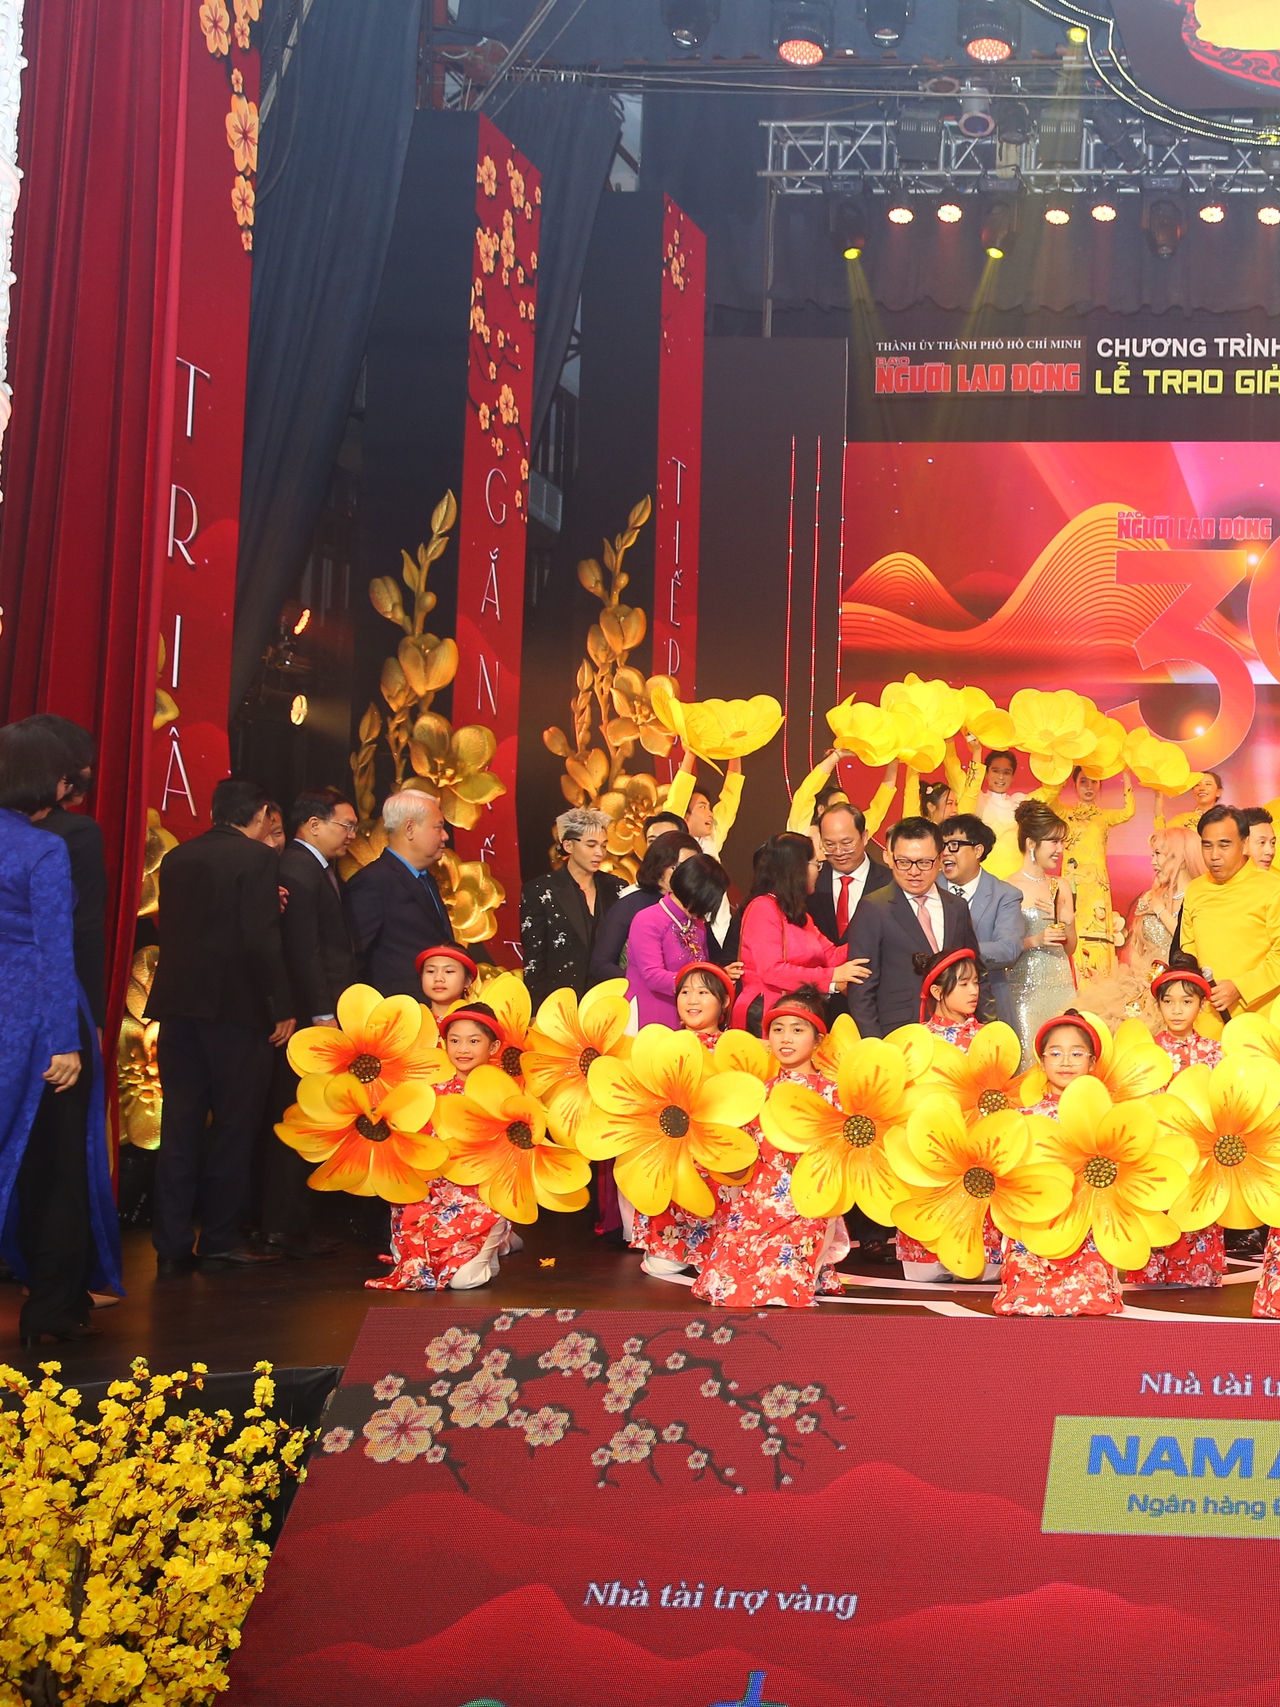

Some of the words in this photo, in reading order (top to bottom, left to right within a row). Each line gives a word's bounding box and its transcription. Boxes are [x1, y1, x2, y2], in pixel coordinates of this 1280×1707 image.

[876, 340, 916, 351] THÀNH
[920, 339, 935, 351] ỦY
[937, 338, 977, 350] THÀNH
[980, 338, 1004, 350] PHỐ
[1007, 338, 1024, 350] HỒ
[1026, 337, 1048, 350] CHÍ
[1050, 339, 1082, 350] MINH
[1096, 337, 1207, 358] CHƯƠNG
[875, 362, 951, 394] NGƯỜI
[957, 364, 1006, 392] LAO
[1011, 361, 1081, 393] ĐỘNG
[1095, 361, 1131, 395] LỄ
[1142, 369, 1224, 395] TRAO
[1178, 518, 1215, 539] LAO
[1219, 515, 1272, 541] ĐỘNG
[477, 468, 508, 717] GẮN
[1139, 1371, 1204, 1396] Nhà
[1211, 1373, 1252, 1396] tài
[1087, 1434, 1255, 1478] NAM
[1127, 1493, 1196, 1517] Ngân
[1203, 1494, 1266, 1519] hàng
[583, 1579, 649, 1608] Nhà
[660, 1579, 705, 1609] tài
[714, 1584, 769, 1615] trợ
[777, 1584, 858, 1620] vàng
